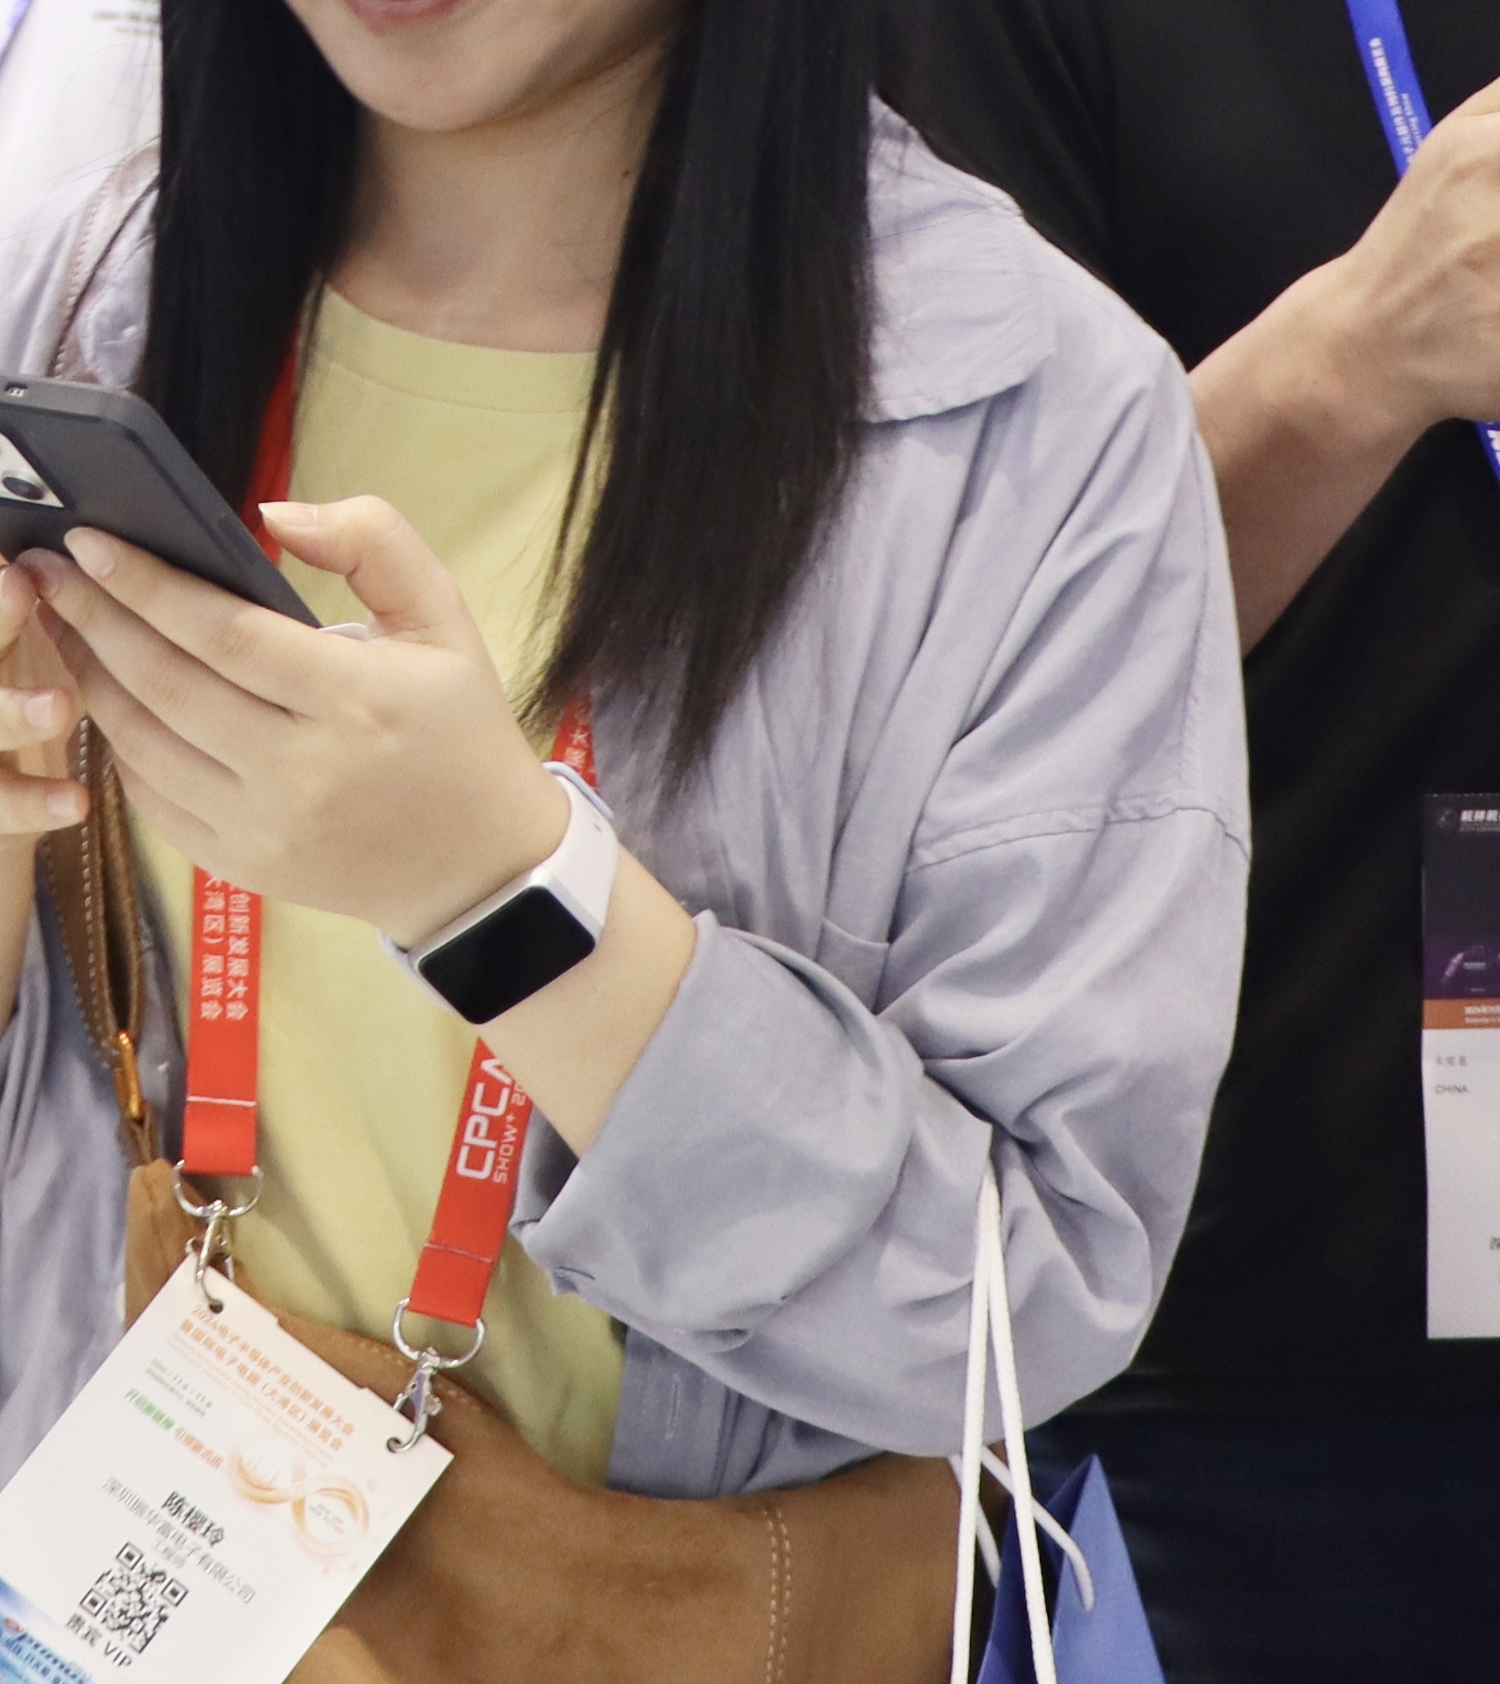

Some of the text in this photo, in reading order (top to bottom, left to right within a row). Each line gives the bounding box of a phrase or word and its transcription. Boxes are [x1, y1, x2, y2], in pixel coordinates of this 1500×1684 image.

[226, 884, 251, 1020] 创新发展大会
[103, 1641, 134, 1670] VIP
